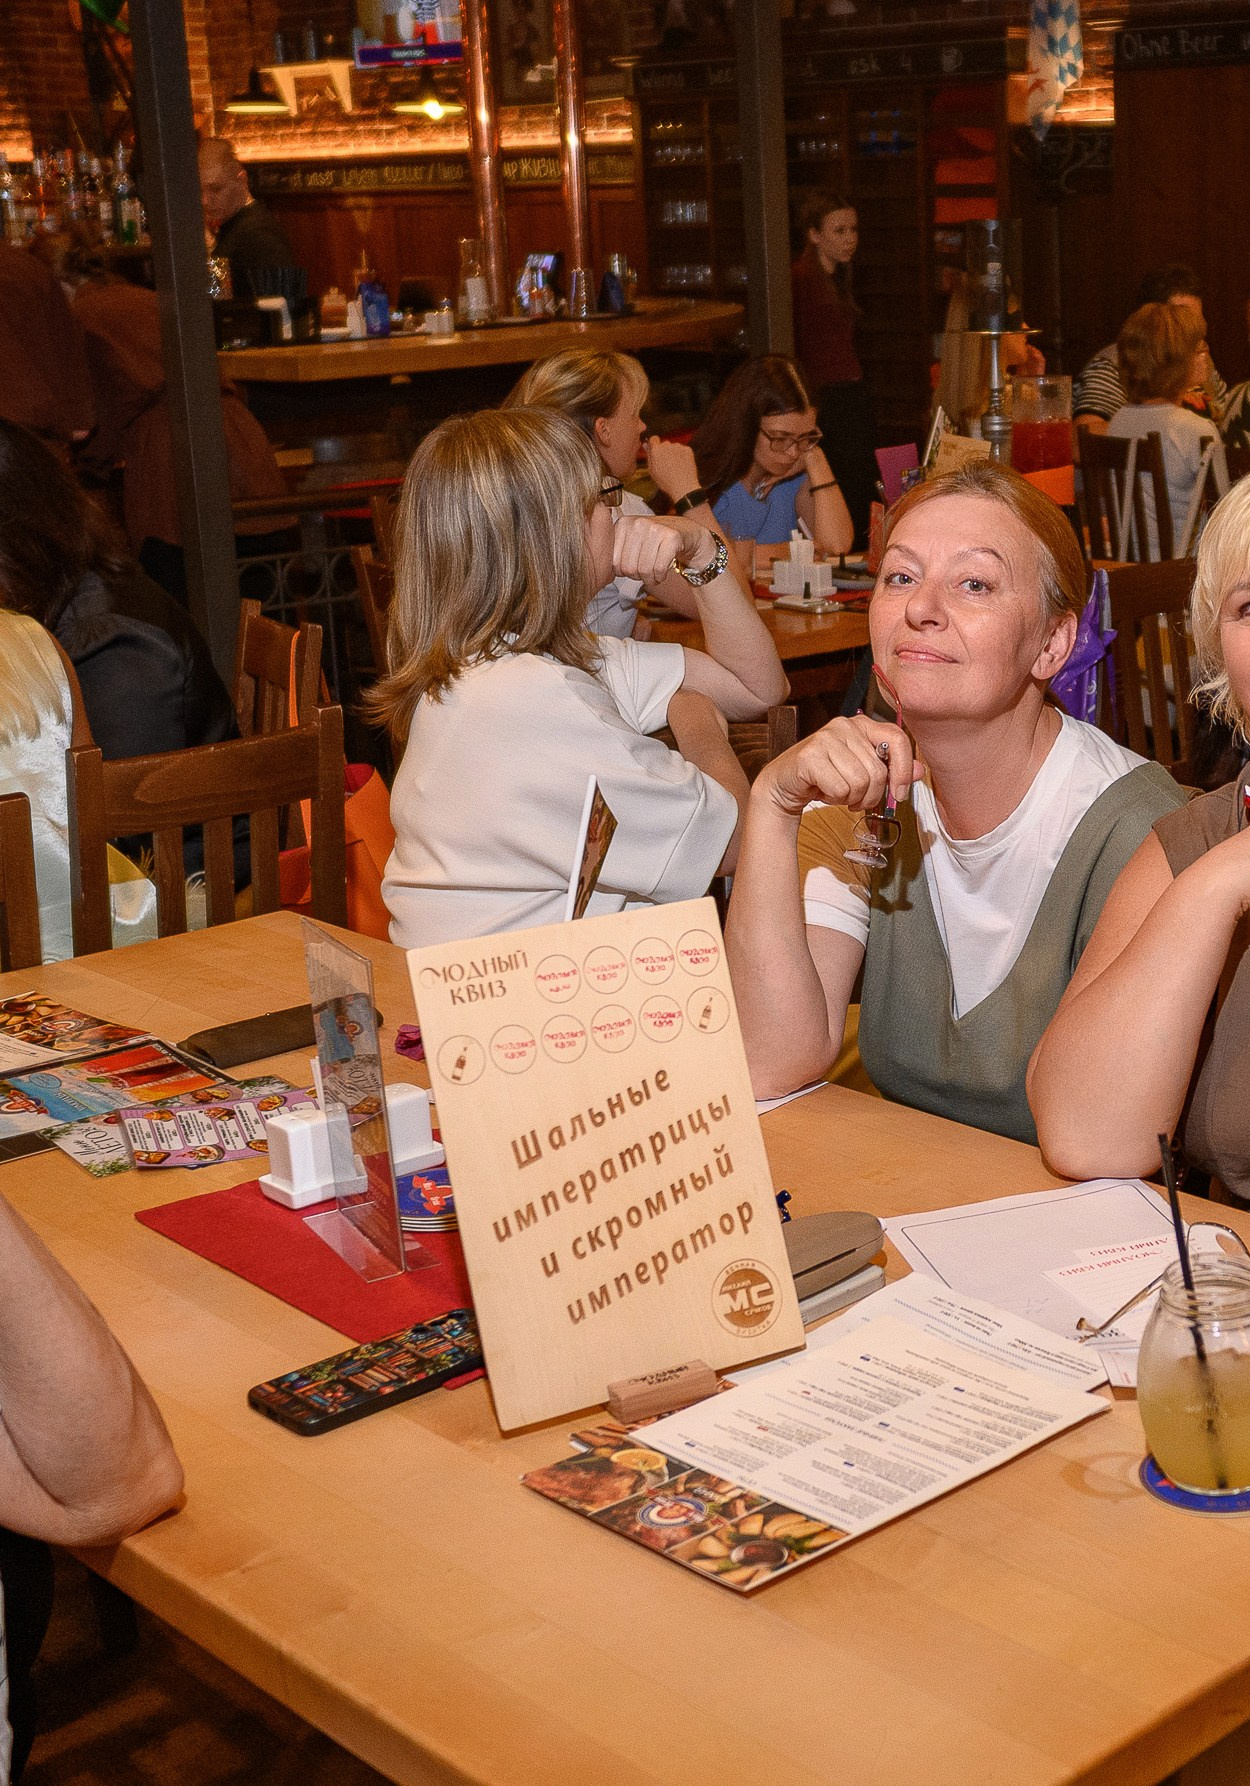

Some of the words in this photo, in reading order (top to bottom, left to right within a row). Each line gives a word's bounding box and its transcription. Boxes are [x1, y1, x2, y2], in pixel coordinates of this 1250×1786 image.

[1121, 29, 1171, 60] Ohne
[418, 949, 529, 989] МОДНЫЙ
[450, 980, 507, 1006] КВИЗ
[510, 1068, 671, 1171] Шальные
[491, 1094, 732, 1243] императрицы
[540, 1251, 561, 1279] и
[571, 1143, 735, 1260] скромный
[566, 1200, 755, 1326] император
[1057, 1262, 1094, 1276] КВИЗ
[719, 1282, 775, 1316] МС
